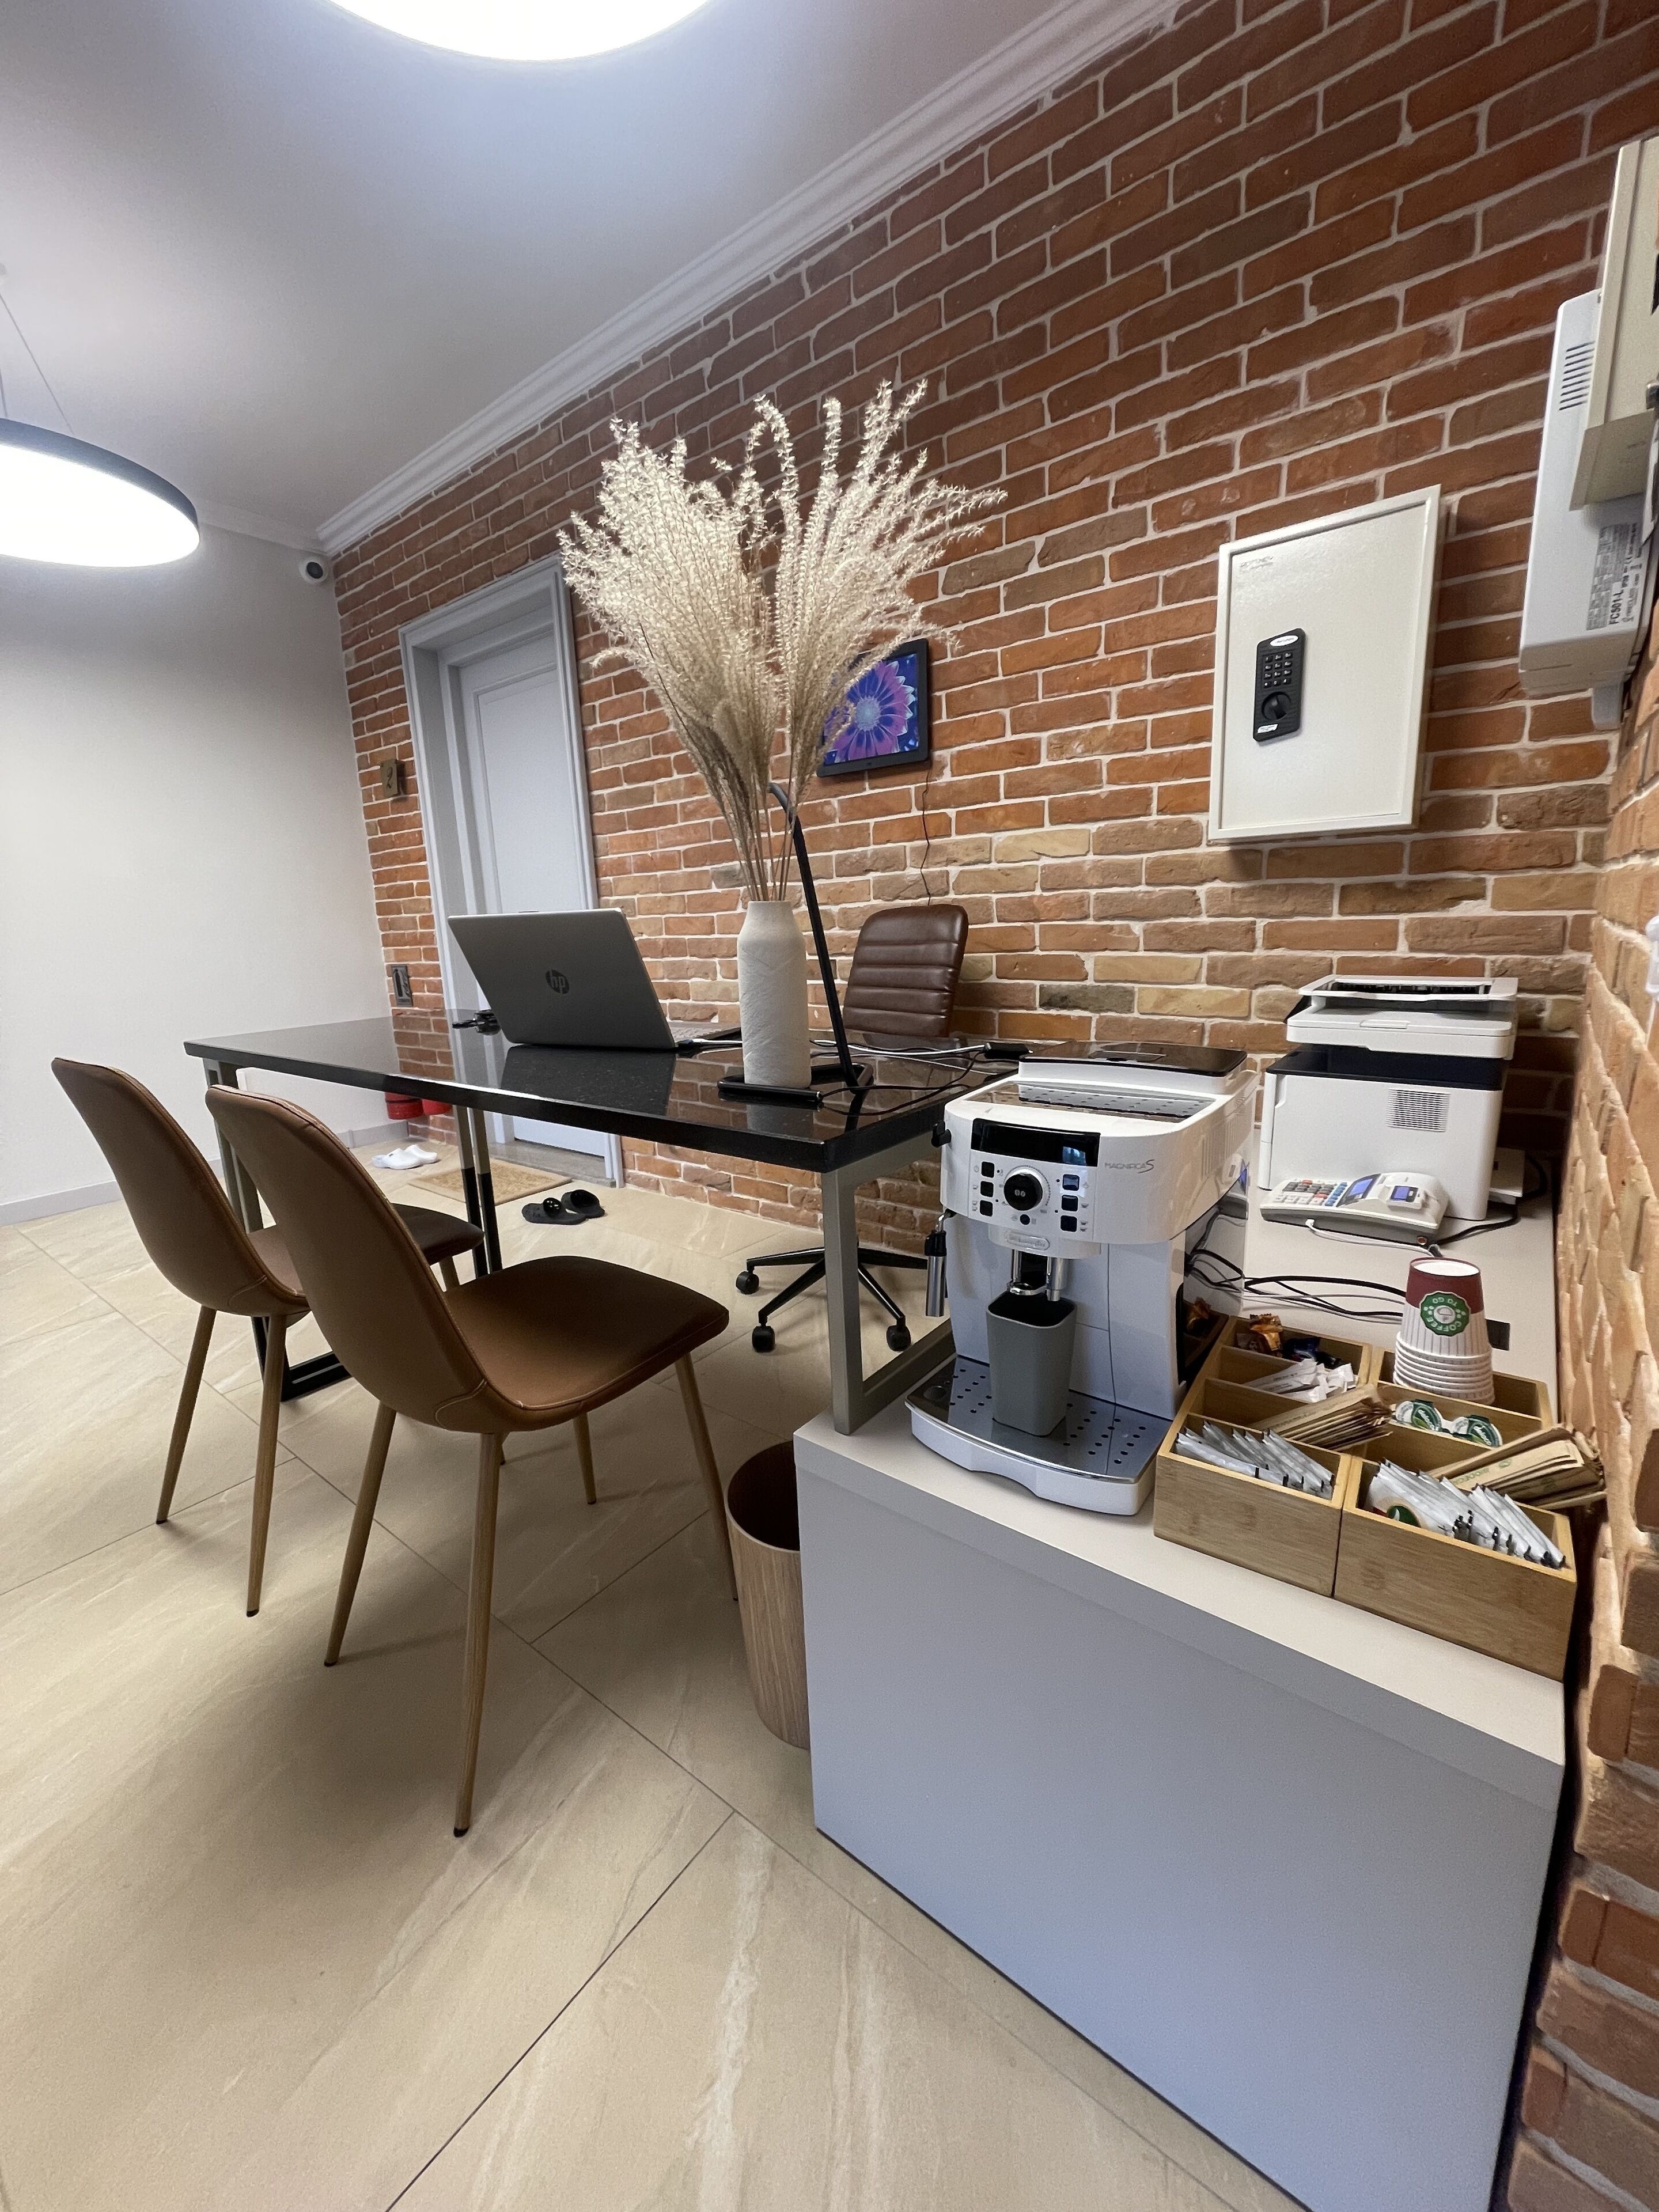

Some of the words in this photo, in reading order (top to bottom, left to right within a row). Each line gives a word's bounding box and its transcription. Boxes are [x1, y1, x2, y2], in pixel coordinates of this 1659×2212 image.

[386, 766, 393, 789] 2
[550, 970, 567, 994] hp
[1447, 1298, 1457, 1307] TO
[1426, 1317, 1462, 1332] COFFEE
